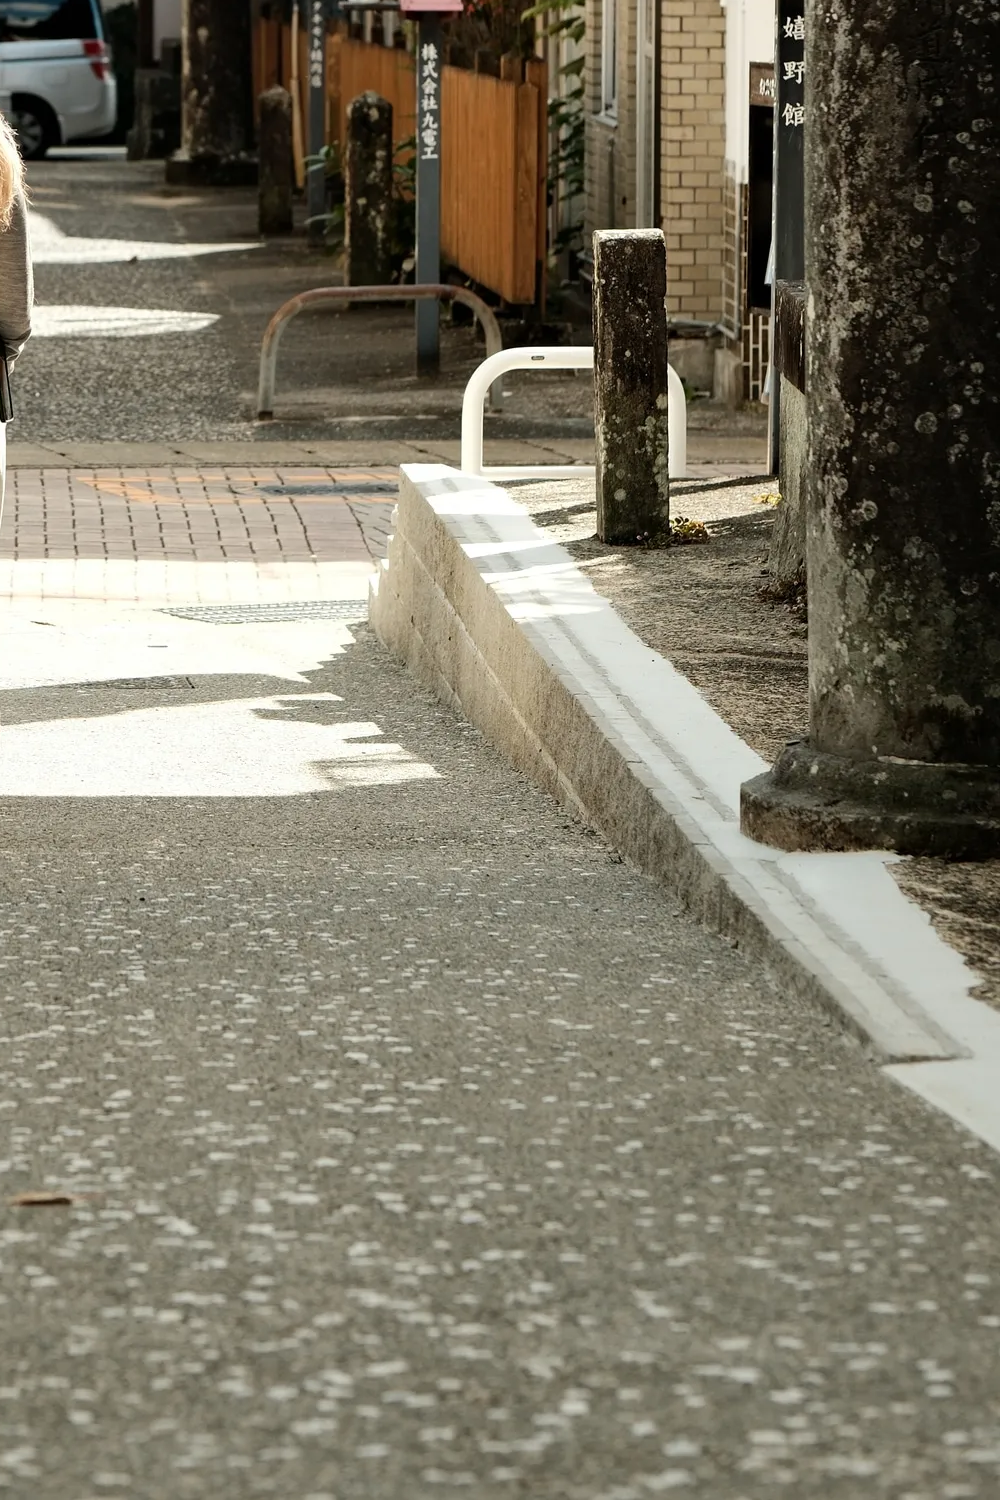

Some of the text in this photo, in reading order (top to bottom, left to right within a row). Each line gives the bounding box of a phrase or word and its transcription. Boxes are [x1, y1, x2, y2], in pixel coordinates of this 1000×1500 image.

[421, 43, 439, 160] 株式会社九電工
[782, 15, 806, 127] 嬉野館
